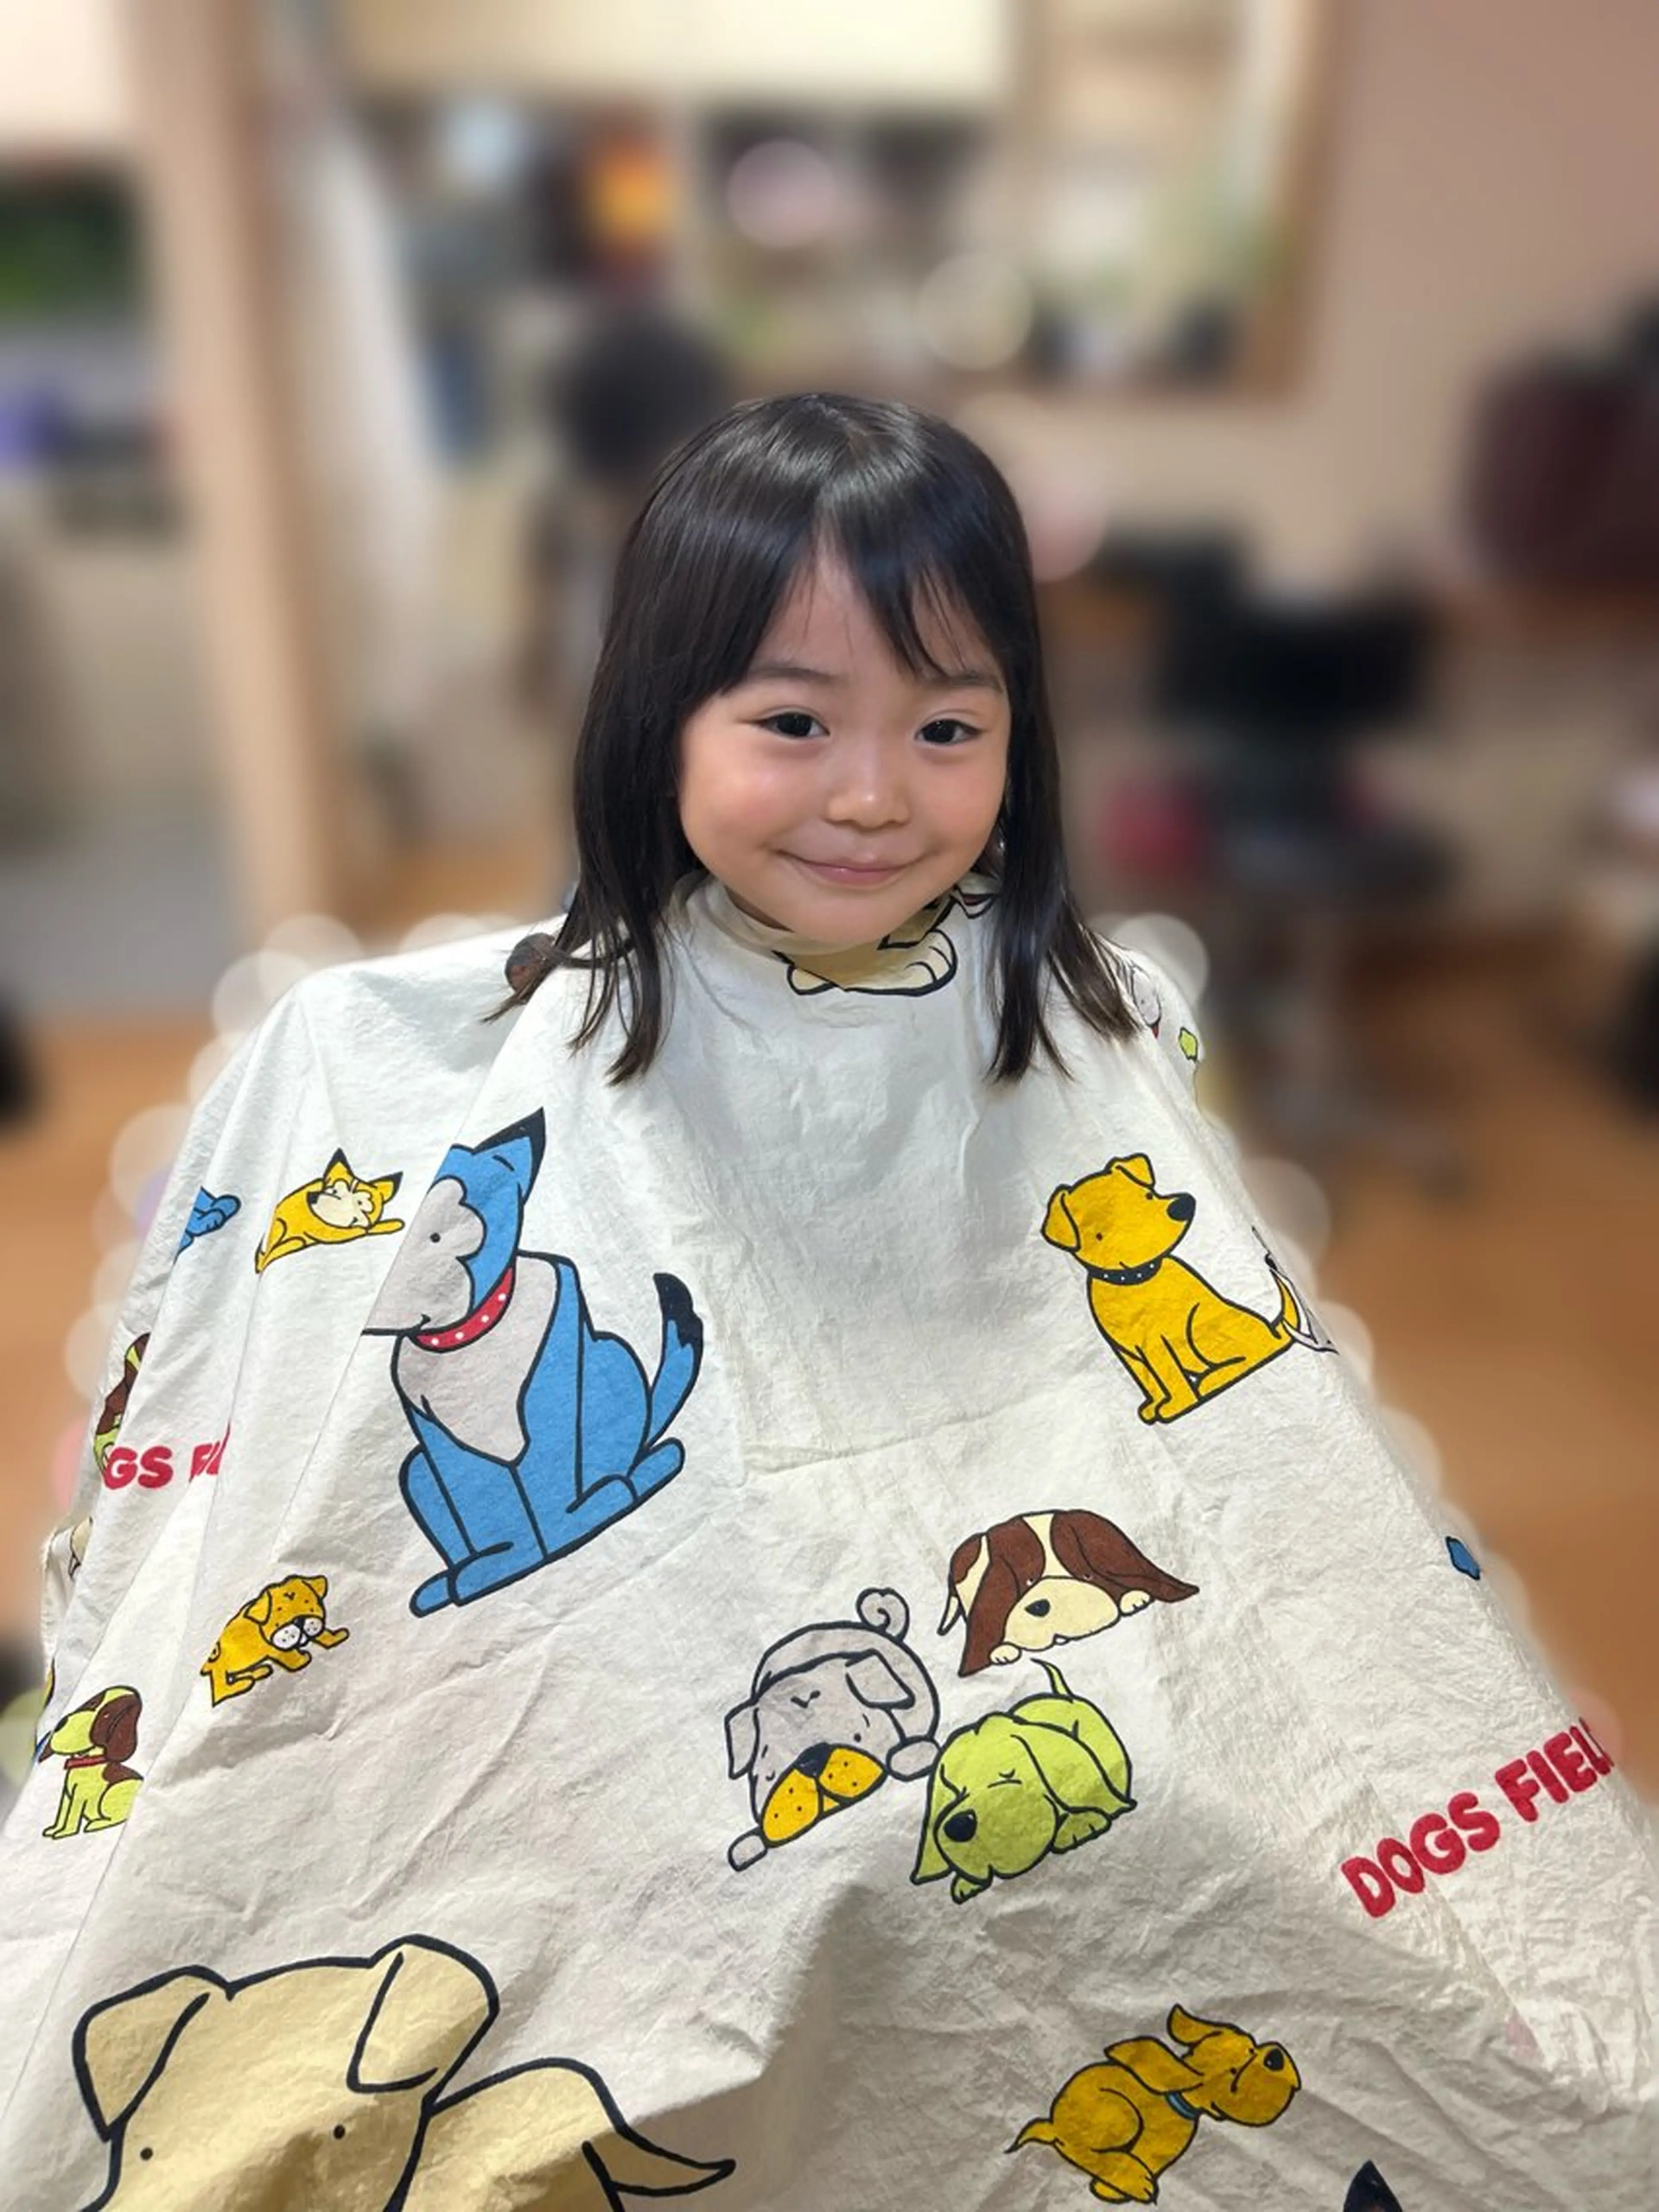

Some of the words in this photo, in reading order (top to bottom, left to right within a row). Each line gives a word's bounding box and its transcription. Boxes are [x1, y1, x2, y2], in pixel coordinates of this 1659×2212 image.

[103, 1446, 173, 1489] GS
[1340, 1792, 1500, 1918] DOGS
[1495, 1717, 1615, 1823] FIEL
